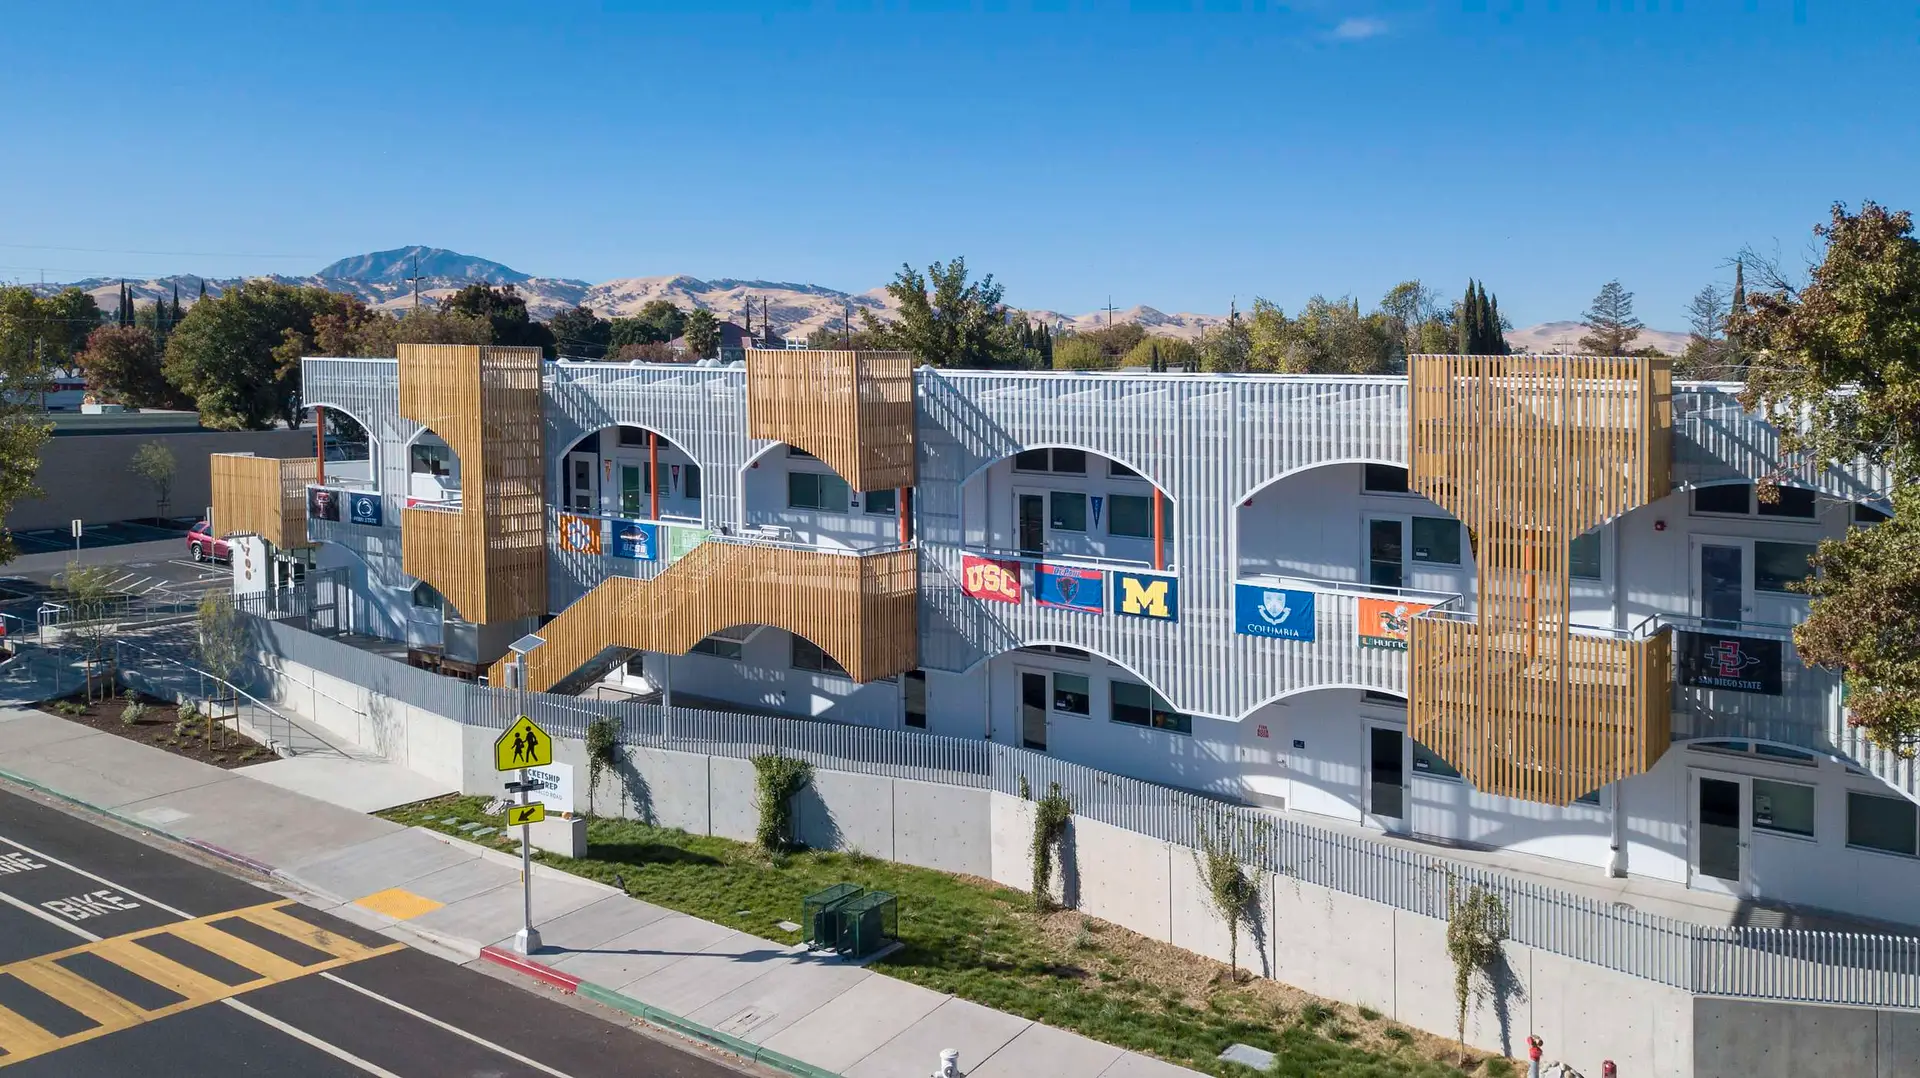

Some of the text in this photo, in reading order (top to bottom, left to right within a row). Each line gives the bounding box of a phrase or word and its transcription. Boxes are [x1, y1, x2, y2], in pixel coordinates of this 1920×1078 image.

[966, 564, 1017, 598] USC
[1122, 577, 1169, 617] M
[1247, 623, 1299, 637] COLUMBIA
[1698, 675, 1761, 690] SAN DIEGO STATE
[527, 768, 561, 783] CKETSHIP
[40, 890, 141, 920] BIKE
